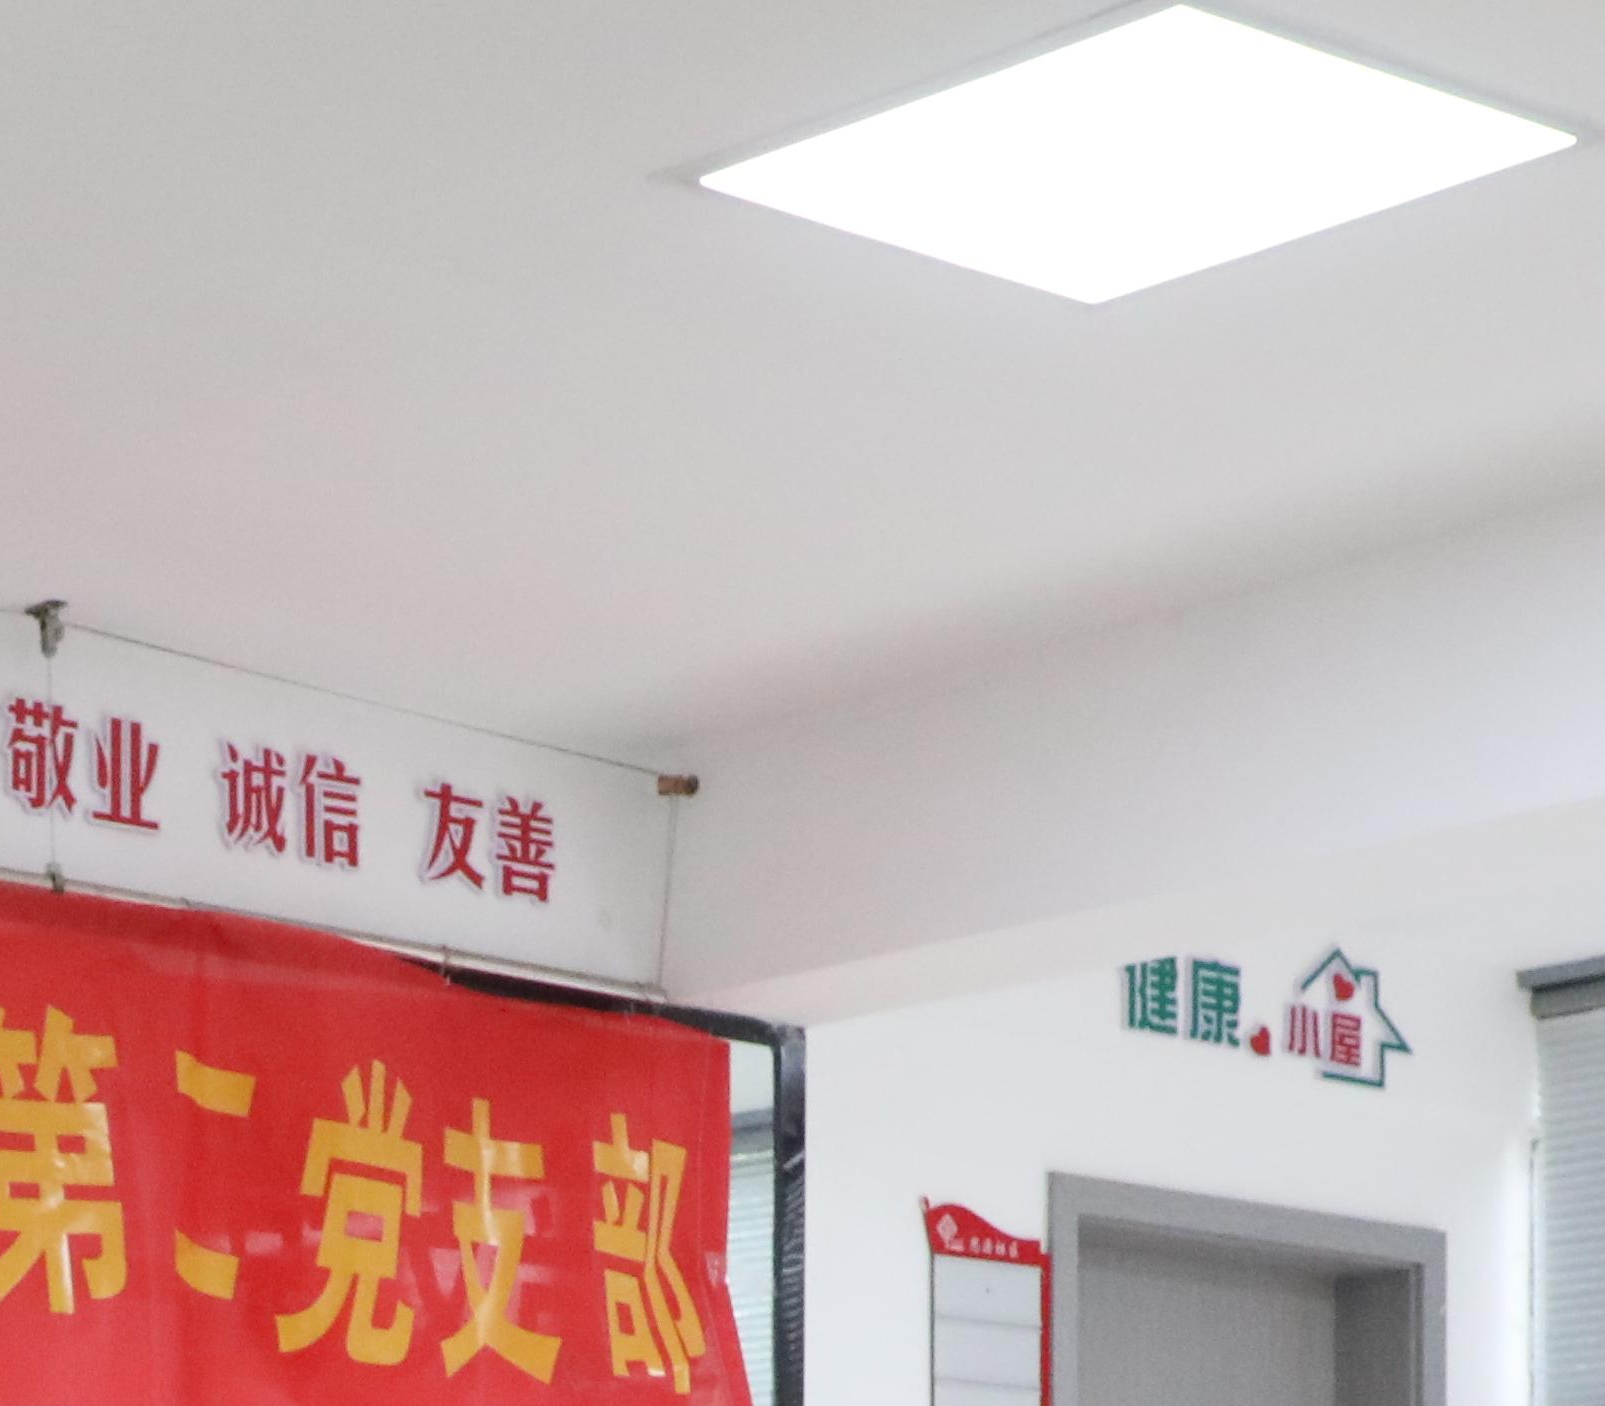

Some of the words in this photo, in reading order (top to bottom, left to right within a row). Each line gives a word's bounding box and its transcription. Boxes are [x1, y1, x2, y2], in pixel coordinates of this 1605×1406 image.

[7, 697, 161, 831] 敬业
[221, 744, 361, 867] 诚信
[425, 781, 557, 904] 友善
[1123, 956, 1243, 1048] 健康
[1287, 1002, 1363, 1068] 小屋
